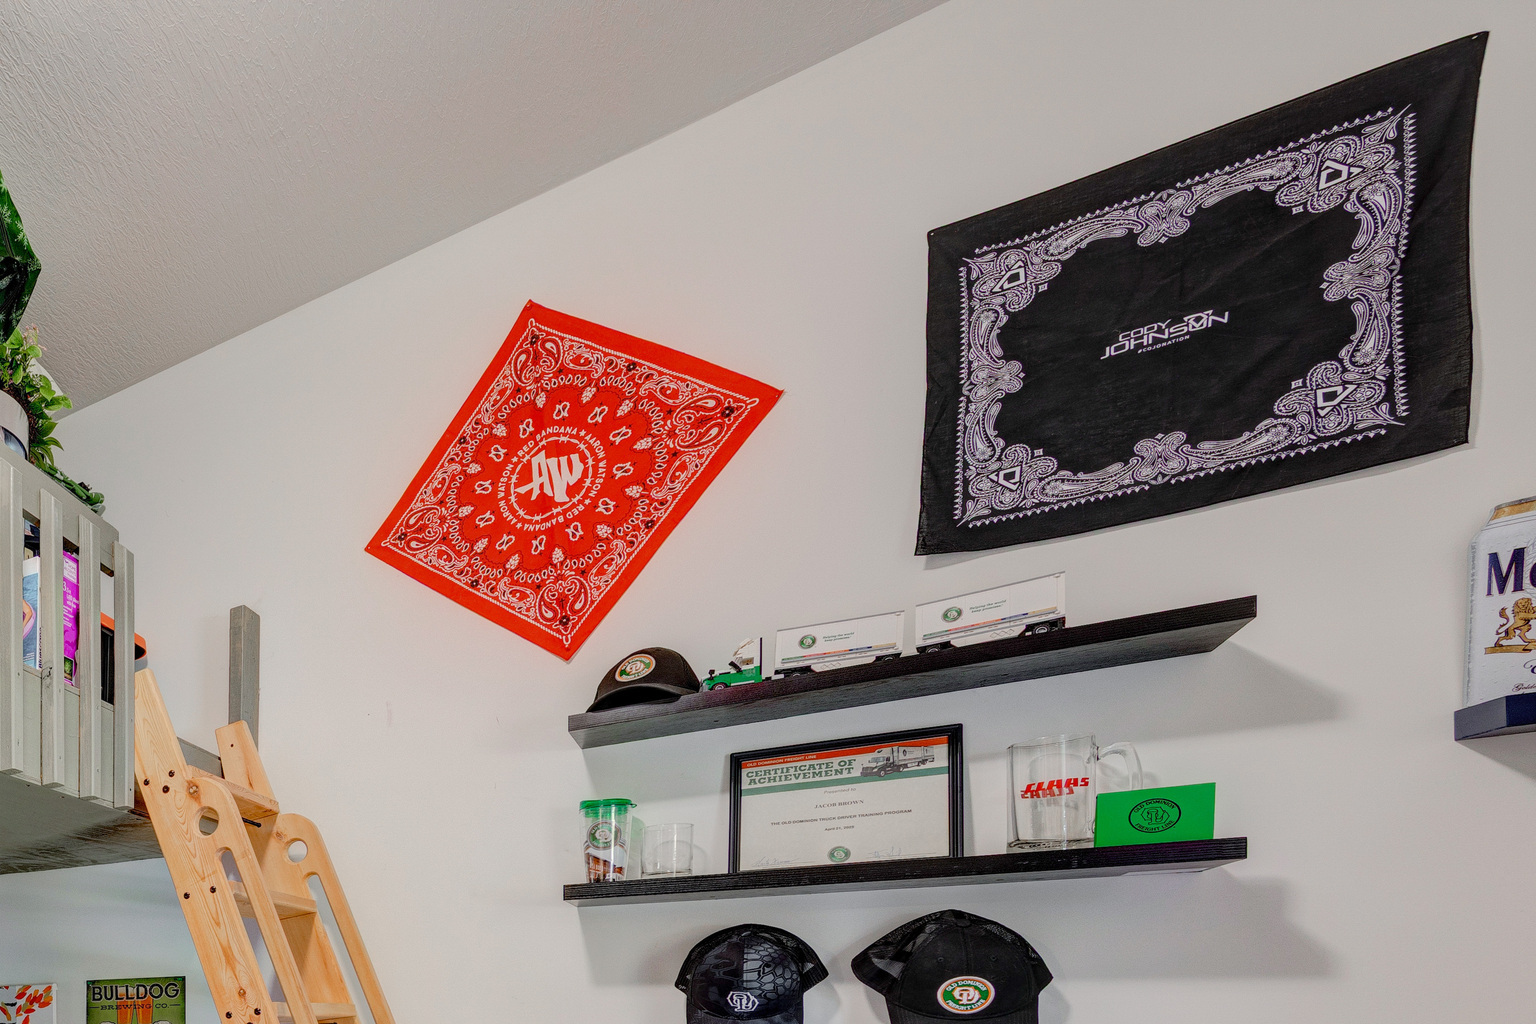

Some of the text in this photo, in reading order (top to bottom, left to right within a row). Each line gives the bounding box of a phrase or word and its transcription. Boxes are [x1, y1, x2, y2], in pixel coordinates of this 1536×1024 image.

[1100, 309, 1229, 360] JOHNSON
[1118, 319, 1171, 341] CODY
[1137, 335, 1190, 354] #COJONATION
[517, 425, 607, 498] RED BANDANA AARON WATSON
[497, 463, 585, 532] RED BANDANA AARON WATSON
[746, 759, 857, 779] CERTIFICATE OF
[747, 767, 854, 785] ACHIEVEMENT
[1024, 777, 1089, 793] CLAAS
[1134, 800, 1175, 813] OLD DOMINION
[1135, 820, 1174, 831] FREIGHT LINE
[92, 982, 179, 1001] BULLDOG
[946, 980, 987, 991] OLD DOMINION
[946, 999, 986, 1010] FREIGHT LINE
